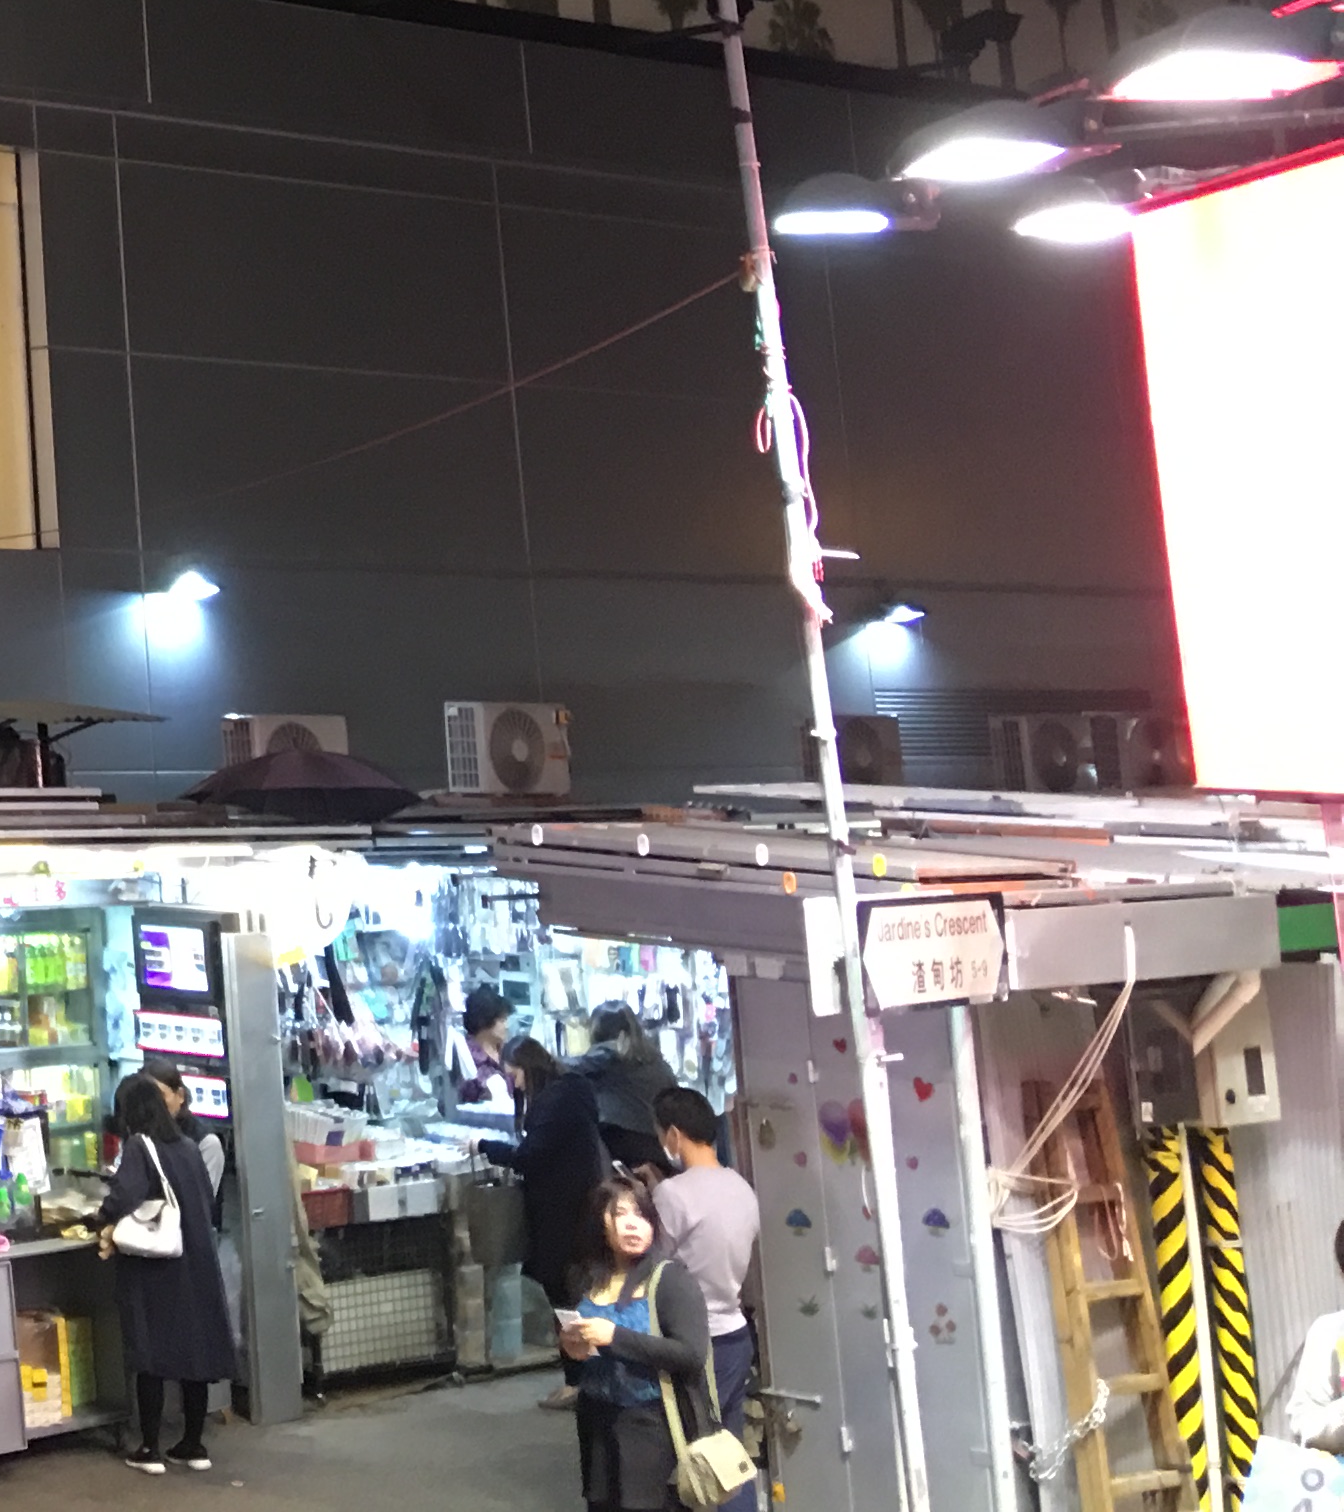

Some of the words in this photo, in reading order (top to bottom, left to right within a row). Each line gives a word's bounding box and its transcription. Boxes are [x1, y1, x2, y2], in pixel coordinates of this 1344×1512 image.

[878, 915, 931, 942] Jardine's
[934, 910, 988, 938] Crescent
[911, 955, 963, 993] 渣甸坊
[970, 959, 988, 979] 5-9
